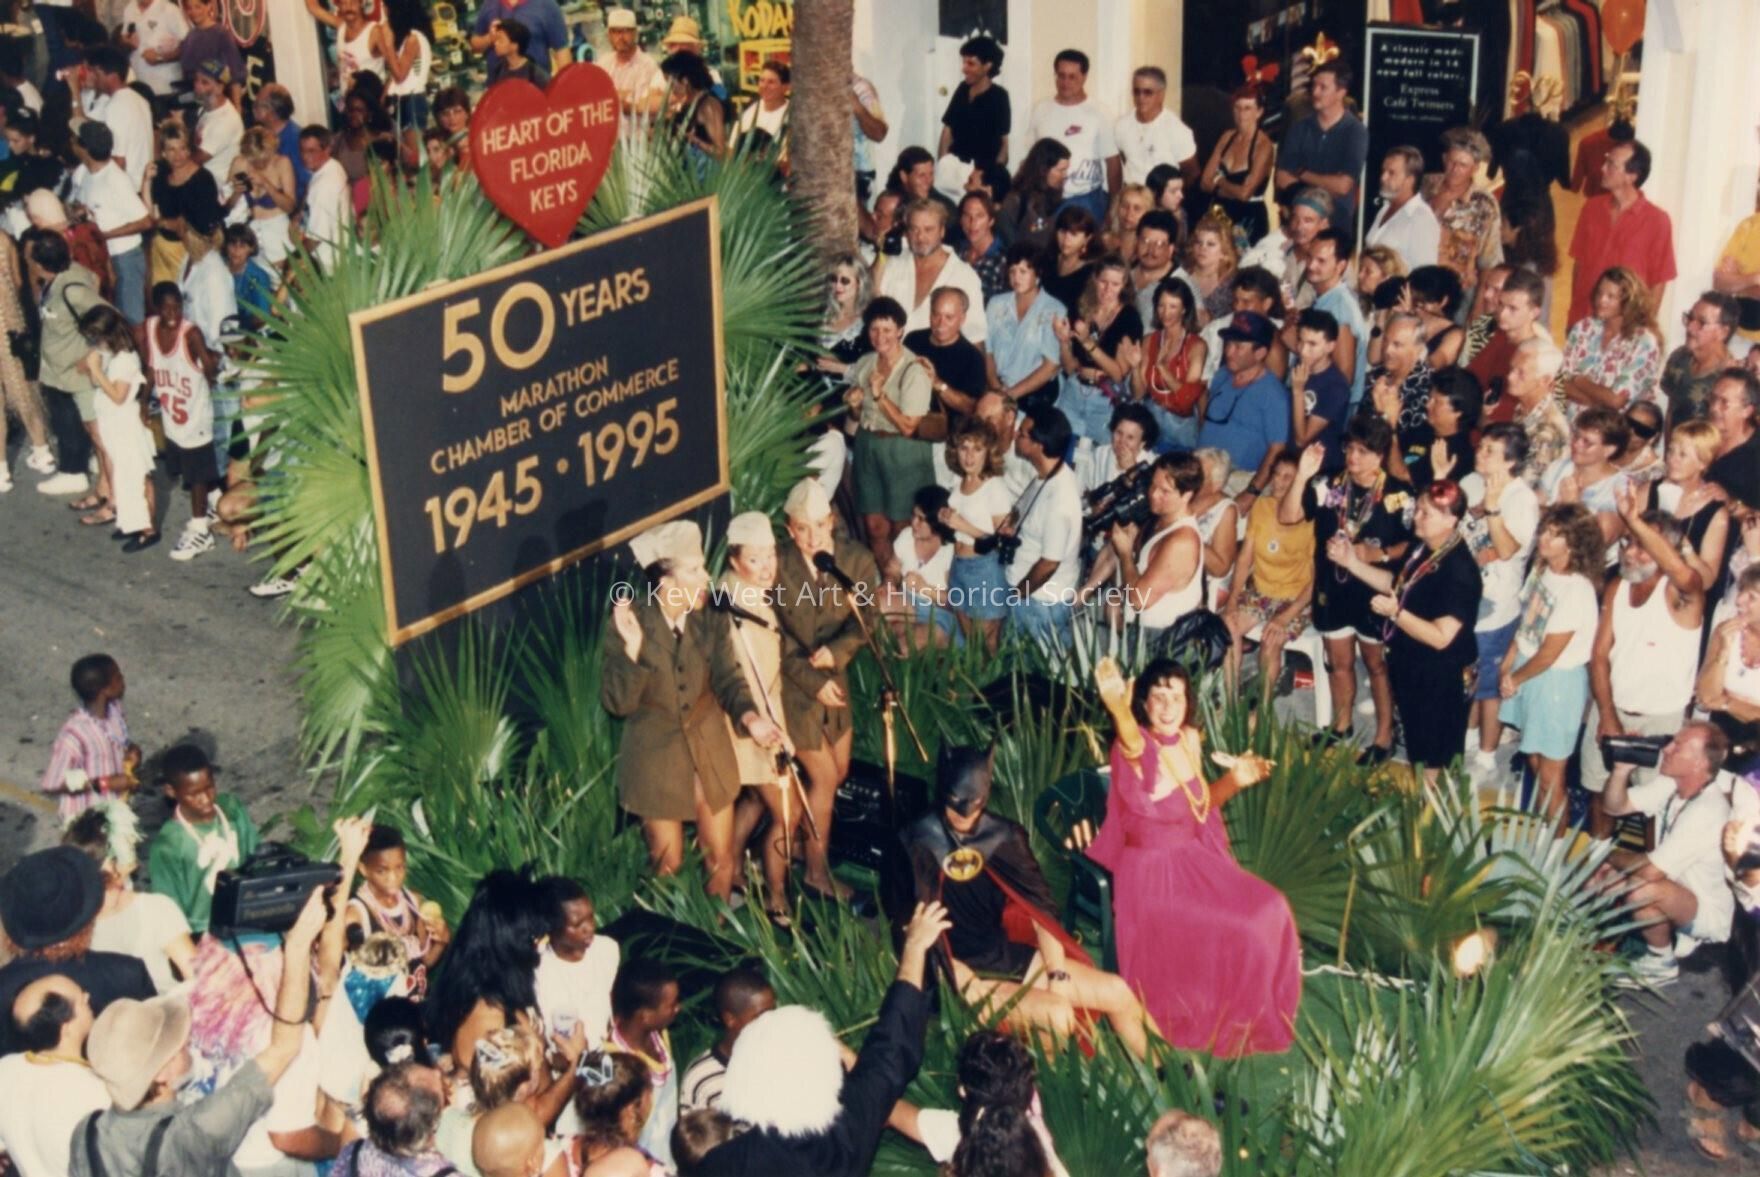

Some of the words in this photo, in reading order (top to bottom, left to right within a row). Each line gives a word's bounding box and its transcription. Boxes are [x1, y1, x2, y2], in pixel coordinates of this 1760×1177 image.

[1384, 57, 1425, 65] modern
[1430, 58, 1440, 66] in
[1392, 45, 1429, 54] classic
[1400, 83, 1440, 96] Express
[481, 116, 542, 155] HEART
[546, 109, 574, 137] OF
[579, 99, 615, 128] THE
[510, 140, 593, 184] FLORIDA
[530, 180, 578, 214] KEYS
[442, 281, 556, 394] 50
[560, 267, 652, 328] YEARS
[500, 355, 609, 418] MARATHON
[430, 419, 532, 475] CHAMBER
[539, 402, 567, 432] OF
[574, 358, 680, 418] COMMERCE
[424, 455, 543, 554] 1945
[578, 398, 680, 487] 1995
